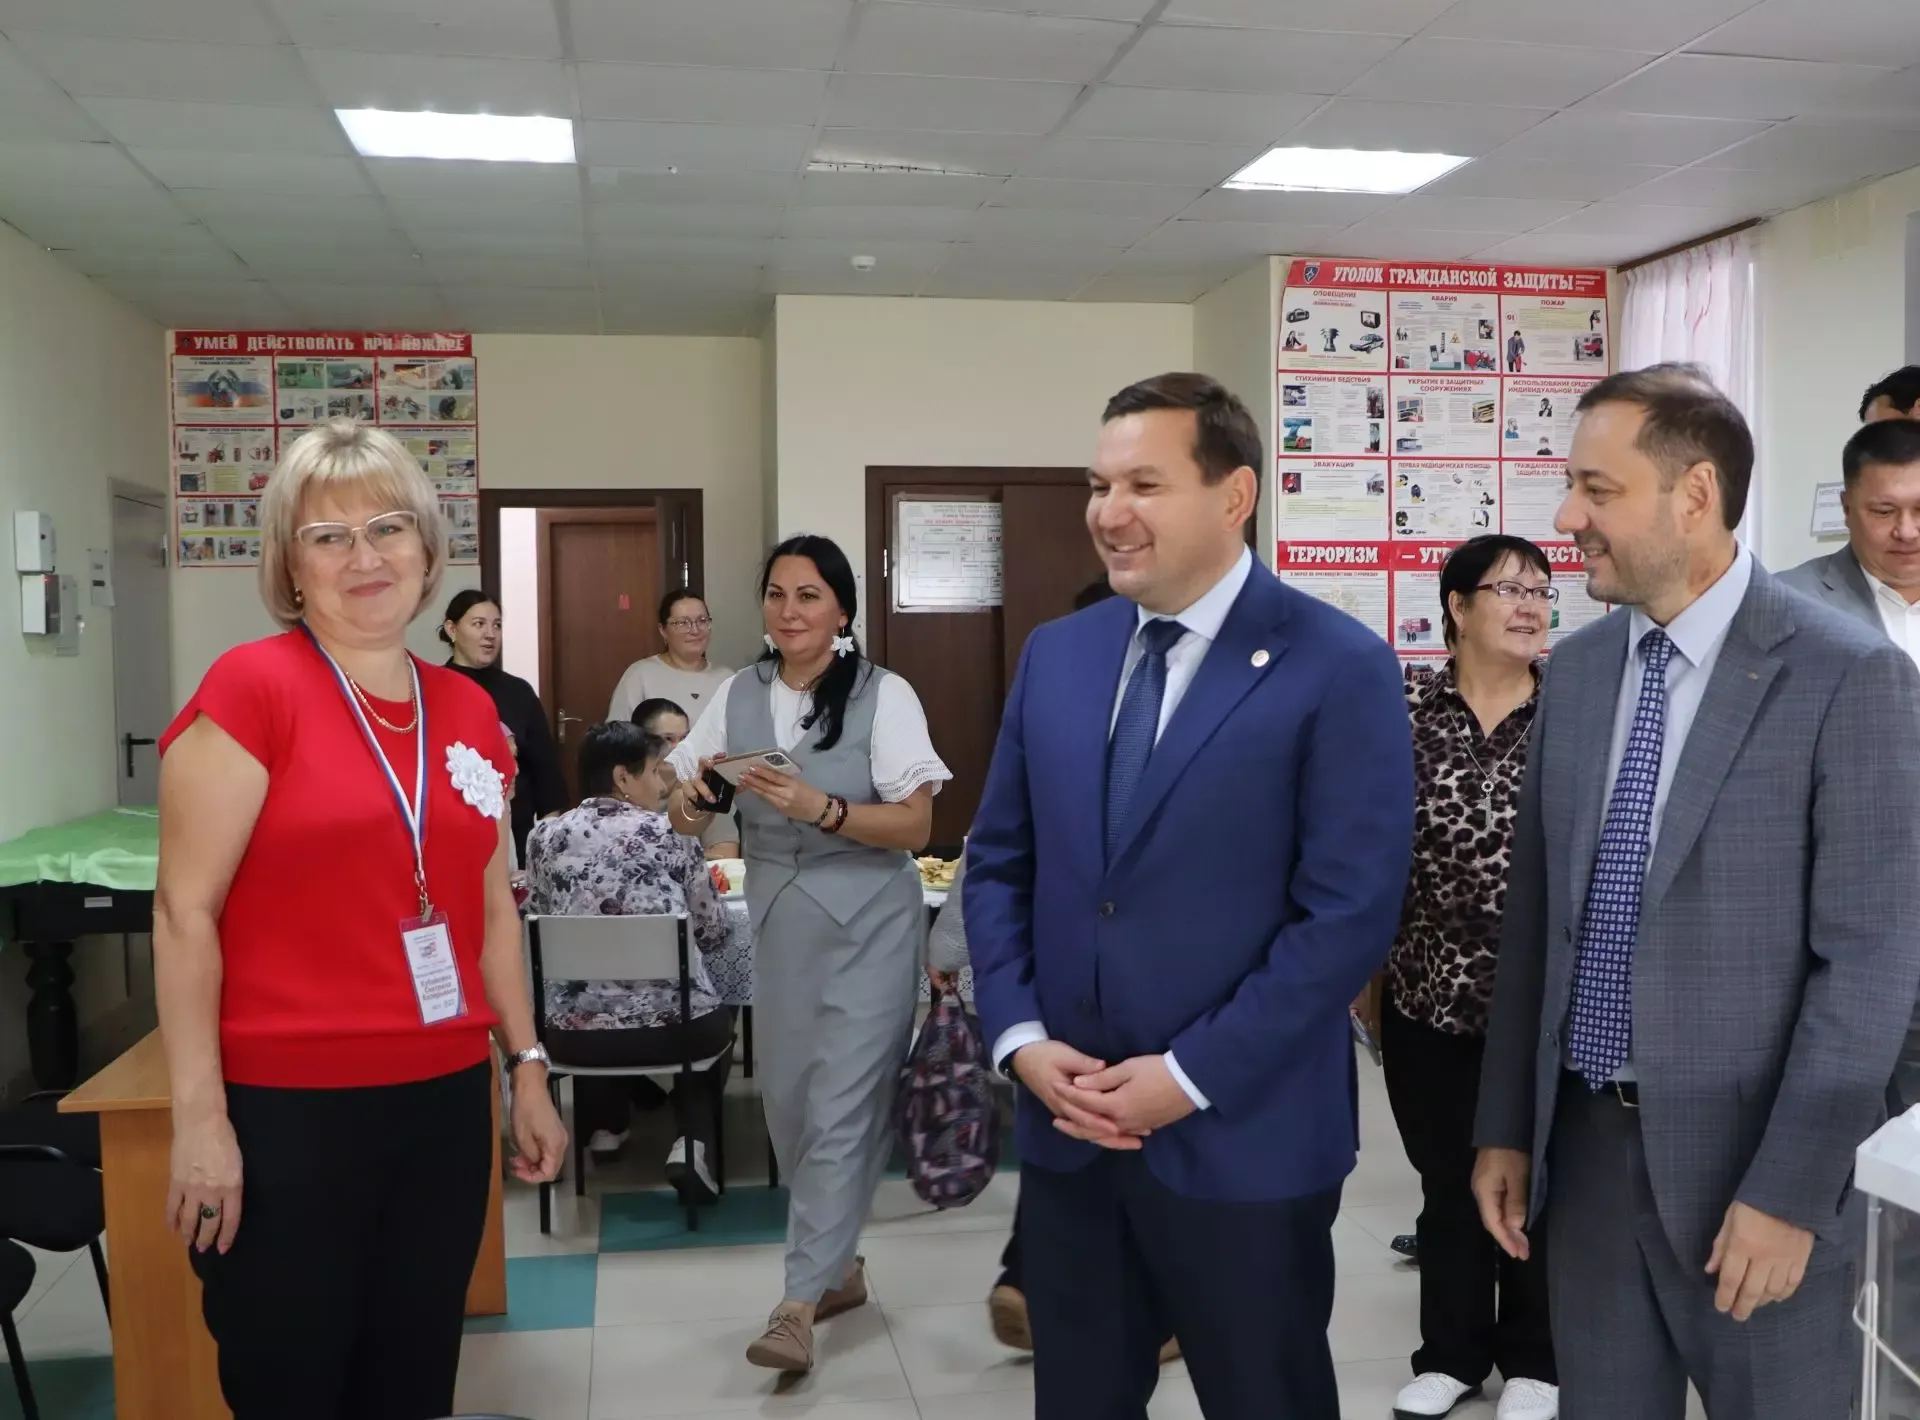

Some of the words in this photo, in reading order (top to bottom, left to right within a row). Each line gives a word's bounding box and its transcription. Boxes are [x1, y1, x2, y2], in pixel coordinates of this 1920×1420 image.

[1332, 266, 1384, 284] УГОЛОК
[1389, 267, 1498, 288] ГРАЖДАНСКОЙ
[1503, 272, 1574, 292] ЗАЩИТЫ
[1313, 290, 1357, 298] ОПОВЕЩЕНИЕ
[193, 334, 238, 350] УМЕЙ
[247, 335, 355, 351] ДЕЙСТВОВАТЬ
[363, 337, 393, 350] ПРИ
[1287, 545, 1379, 564] ТЕРРОРИЗМ
